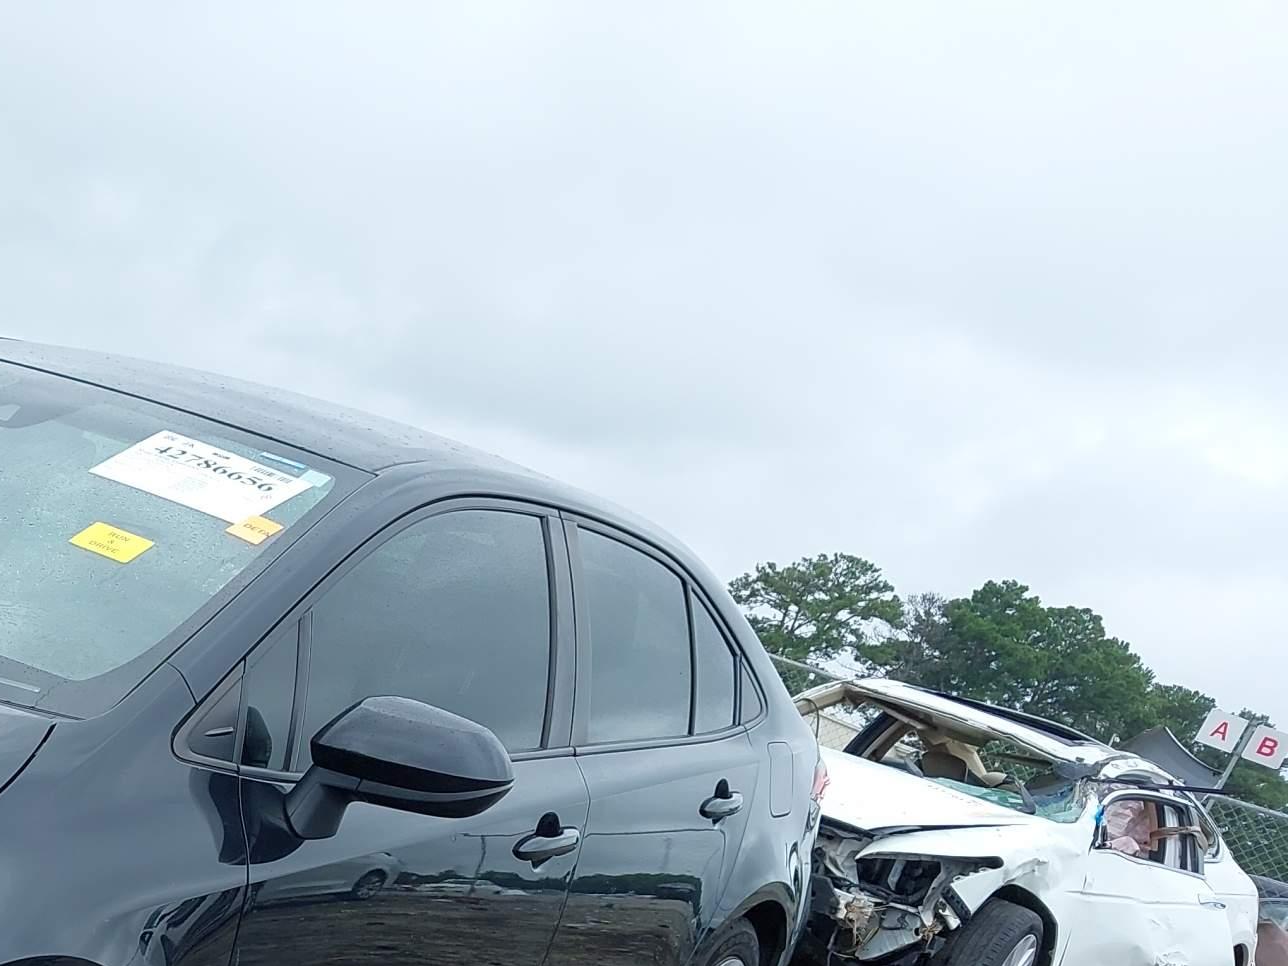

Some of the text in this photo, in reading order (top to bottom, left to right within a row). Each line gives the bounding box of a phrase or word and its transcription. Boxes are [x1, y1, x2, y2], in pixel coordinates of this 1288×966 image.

[154, 446, 274, 493] 42786656
[88, 540, 120, 554] DRIVE
[1209, 721, 1229, 741] A
[1255, 736, 1279, 757] B
